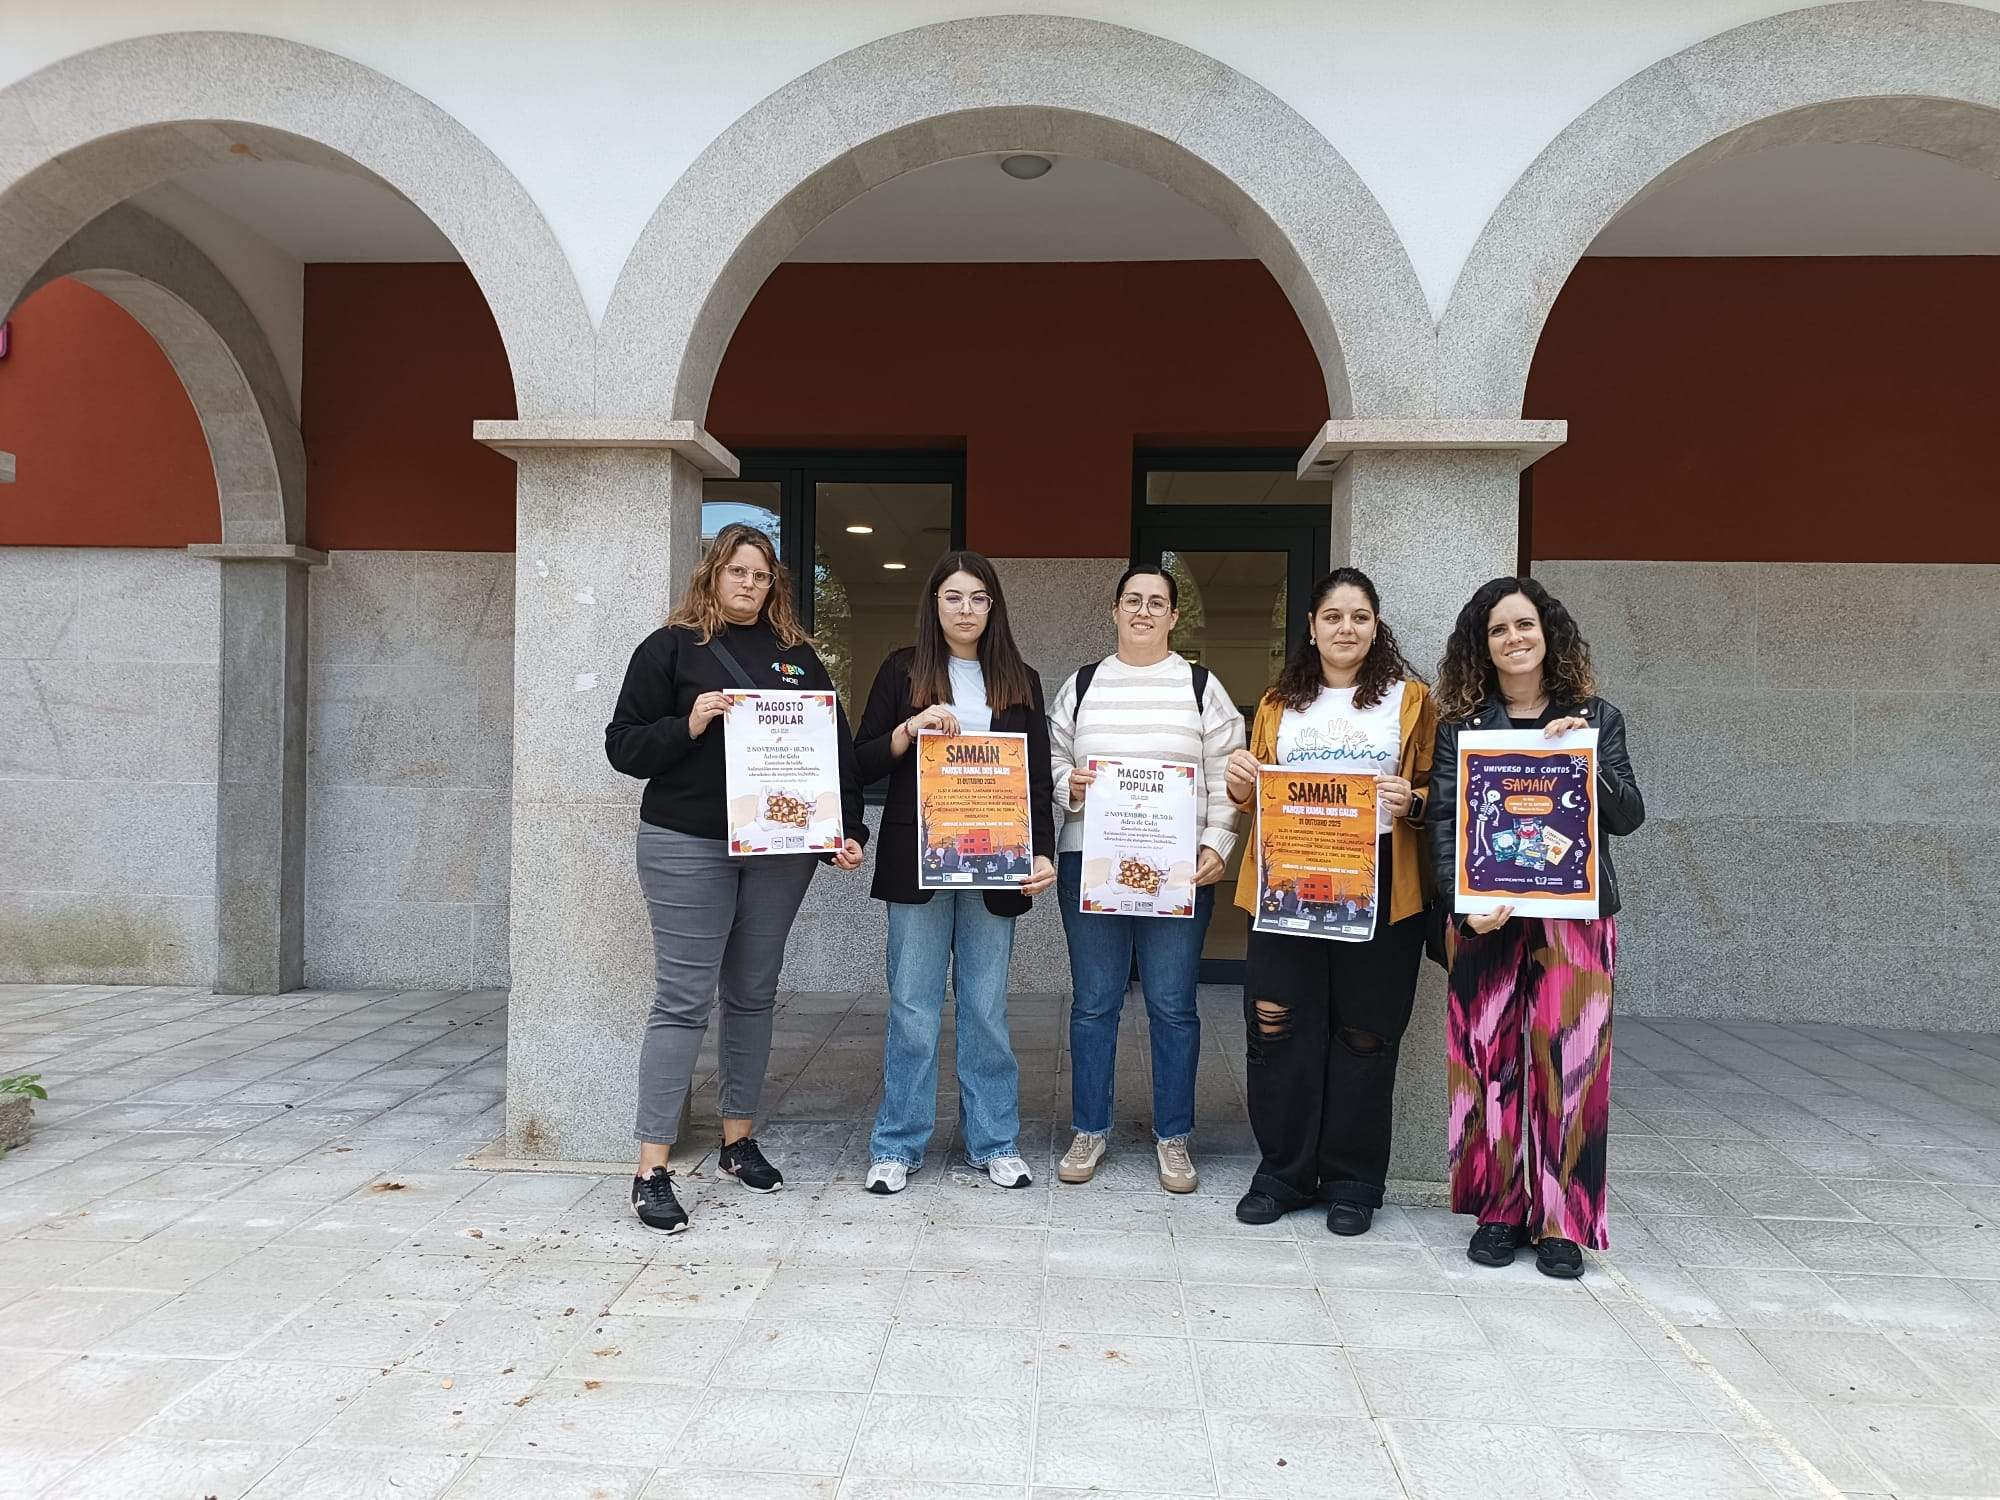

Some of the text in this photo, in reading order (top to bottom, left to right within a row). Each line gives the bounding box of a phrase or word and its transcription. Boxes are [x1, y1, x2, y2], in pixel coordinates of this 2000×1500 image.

[756, 702, 804, 711] MAGOSTO
[758, 714, 804, 724] POPULAR
[946, 741, 1000, 764] SAMAÍN
[1287, 744, 1391, 762] amodiño
[1118, 768, 1165, 780] MAGOSTO
[1120, 781, 1164, 793] POPULAR
[1502, 776, 1558, 792] SAMAÍN
[1288, 778, 1347, 804] SAMAÍN
[1282, 805, 1359, 817] PARQUE RAMAL DOS GALOS
